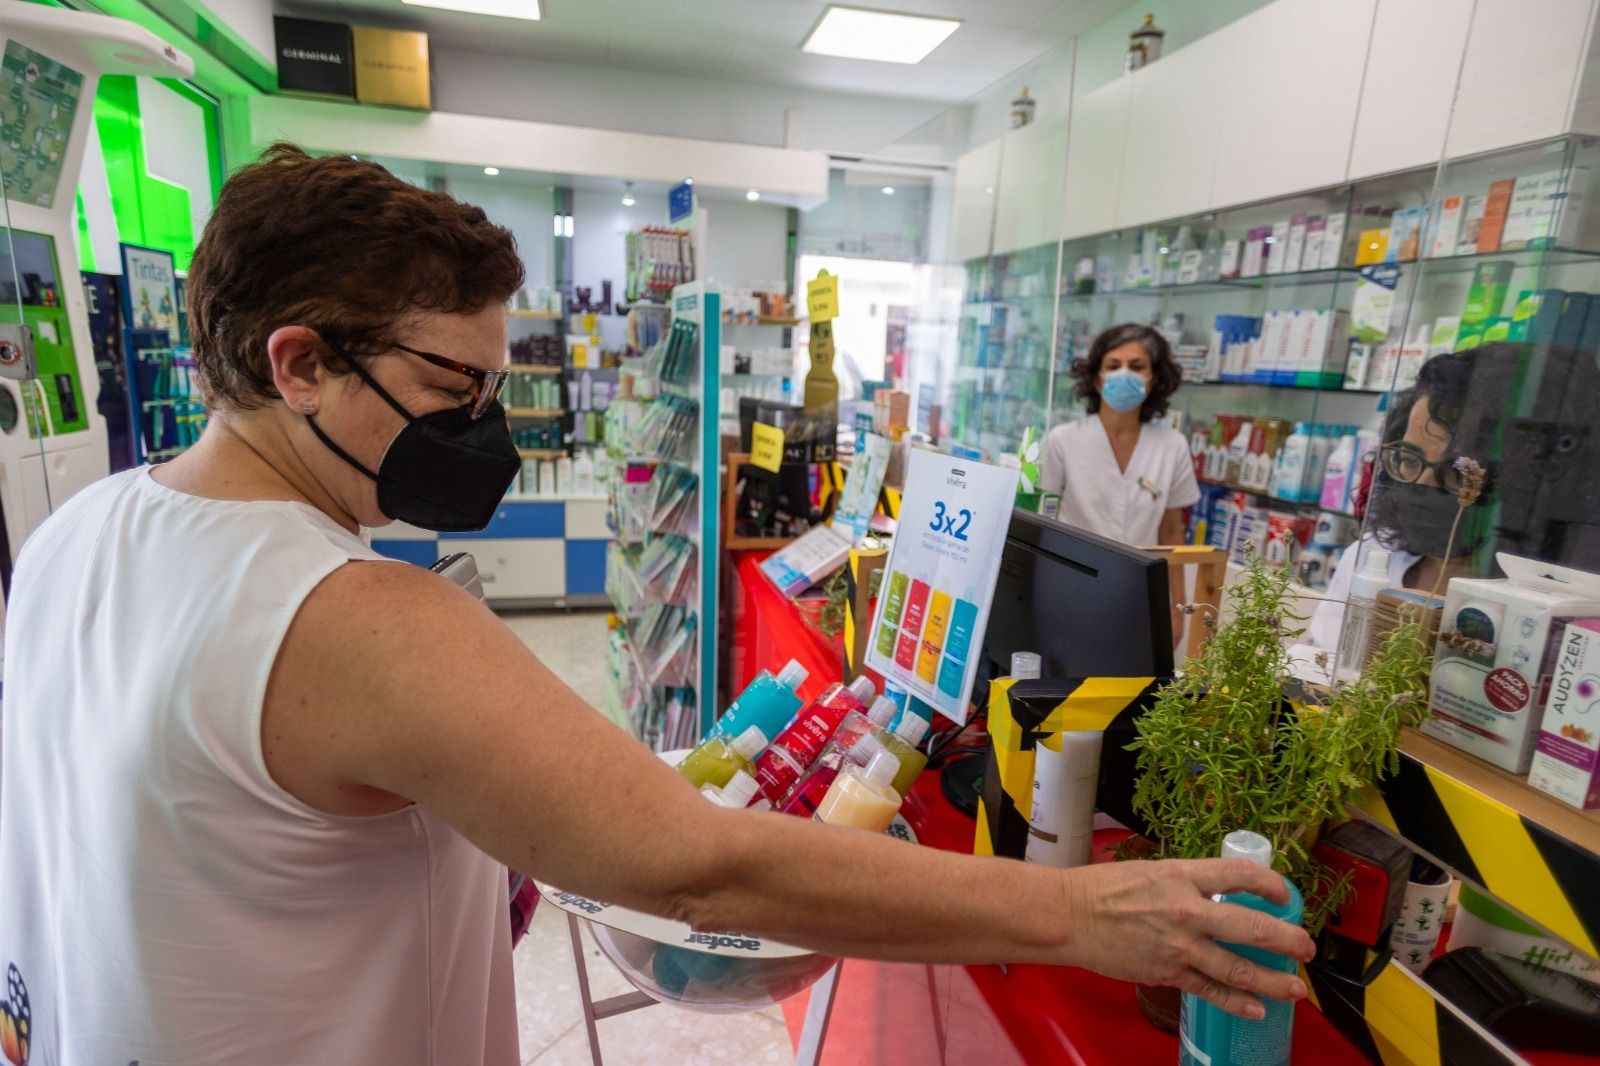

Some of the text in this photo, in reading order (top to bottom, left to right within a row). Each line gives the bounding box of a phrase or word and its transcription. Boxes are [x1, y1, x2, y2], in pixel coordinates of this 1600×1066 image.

[282, 47, 342, 65] GERMINAL
[131, 256, 170, 283] Tintas
[1491, 674, 1527, 701] AHORRO
[1501, 671, 1526, 691] PACK
[553, 891, 603, 914] acofar
[684, 933, 761, 951] acofar
